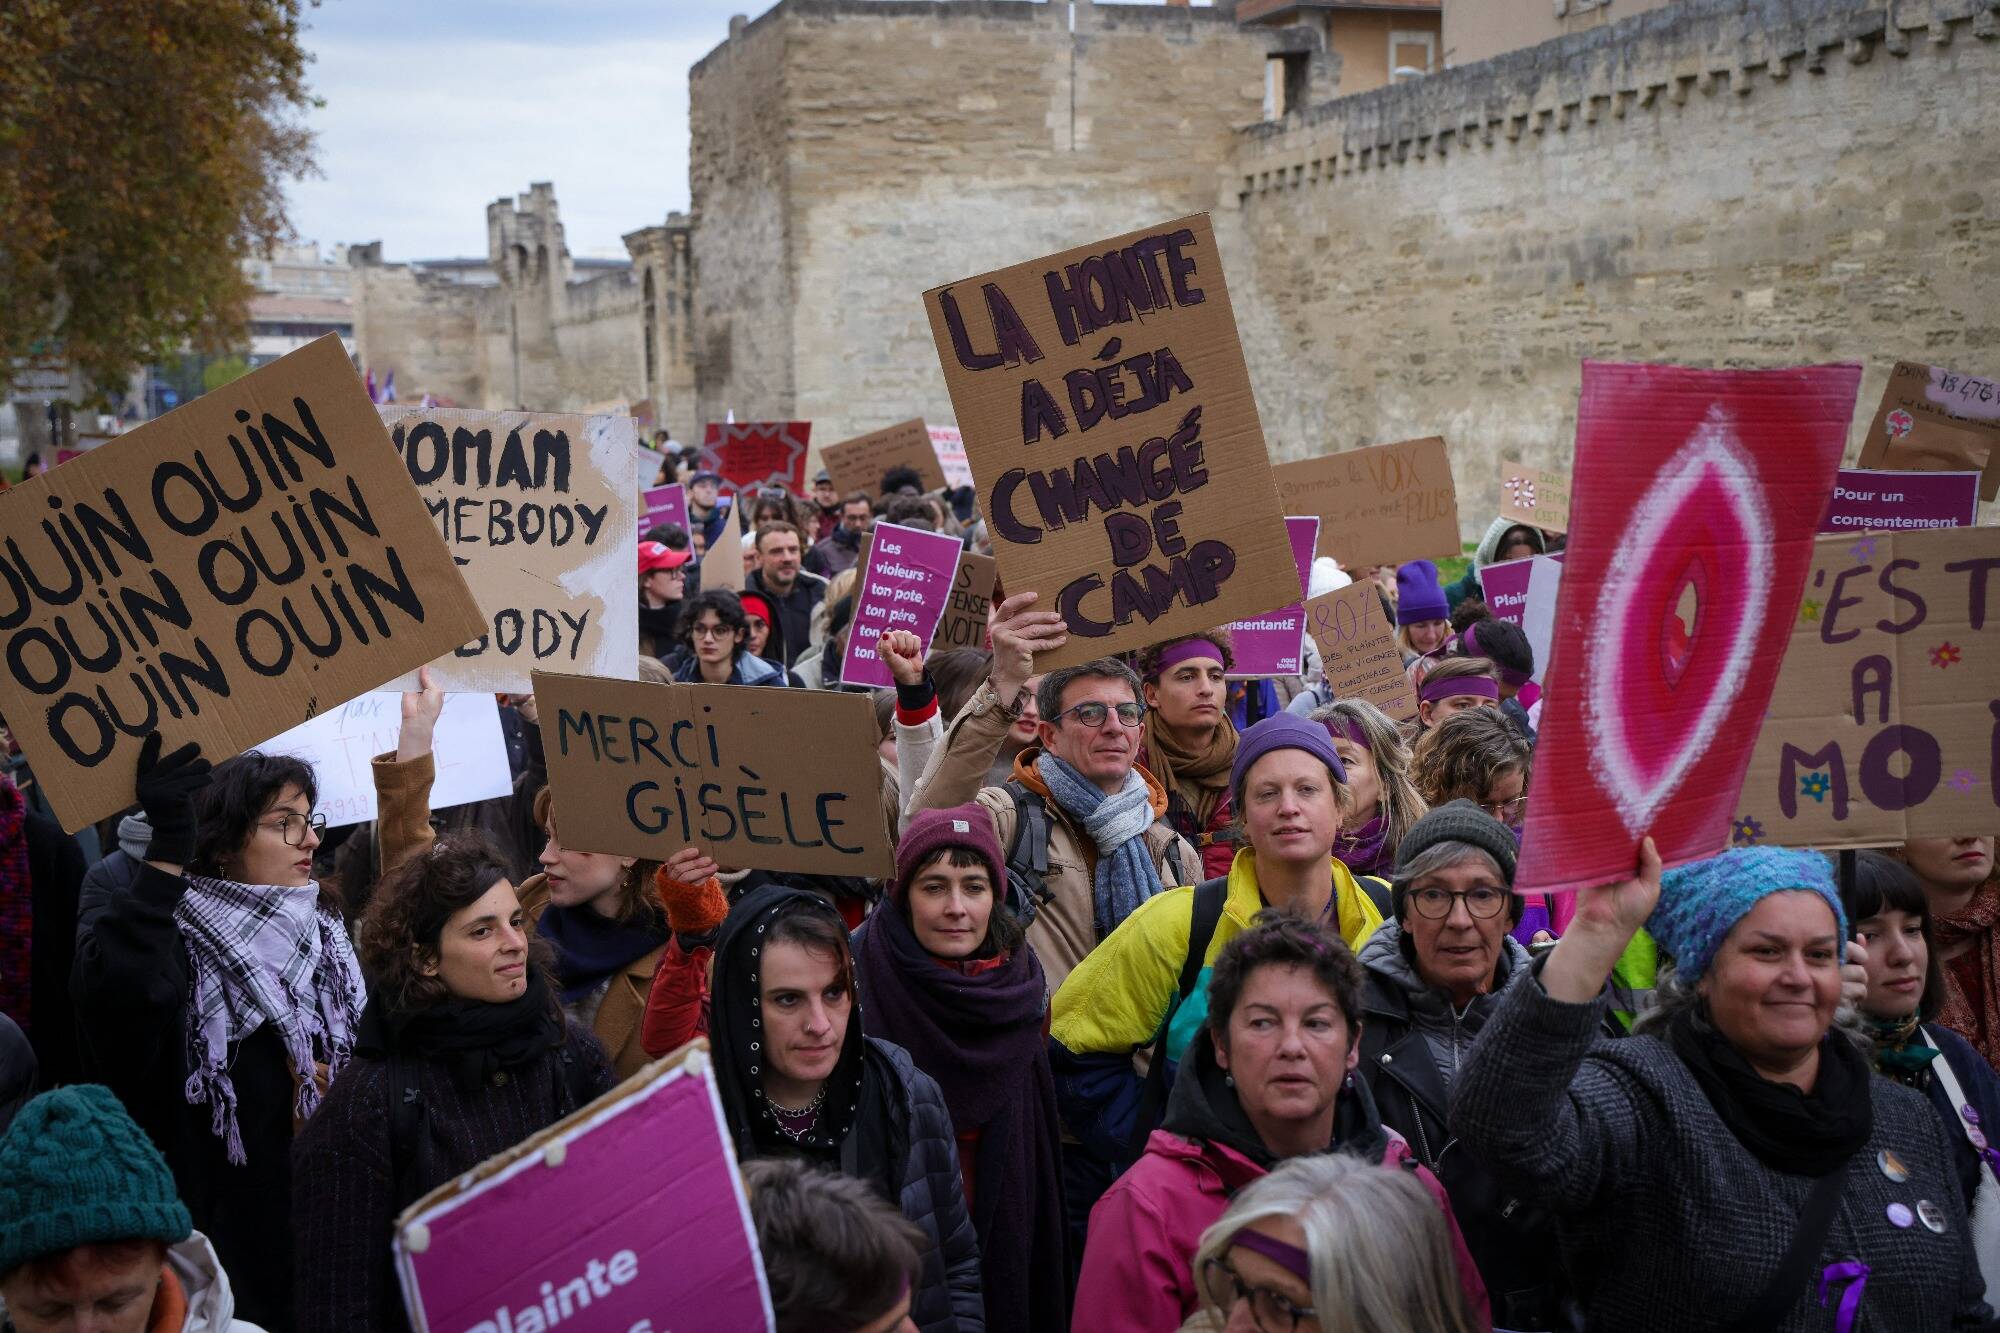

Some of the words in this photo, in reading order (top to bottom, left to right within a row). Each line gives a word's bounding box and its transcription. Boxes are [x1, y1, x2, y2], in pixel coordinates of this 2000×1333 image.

[938, 283, 1045, 371] LA
[1044, 228, 1205, 347] HONTE
[1020, 378, 1068, 445] A
[990, 405, 1209, 544] CHANGÉ
[1366, 449, 1422, 494] VOIX
[1403, 486, 1451, 526] PLUS
[1833, 487, 1876, 502] Pour
[1881, 492, 1904, 502] un
[423, 497, 608, 547] MEBODY
[1103, 500, 1186, 568] DE
[1831, 515, 1959, 529] consentement
[879, 539, 902, 555] Les
[876, 561, 925, 582] violeurs
[871, 582, 892, 598] ton
[894, 588, 926, 606] pote,
[1055, 539, 1236, 638] CAMP
[865, 603, 886, 618] ton
[859, 624, 880, 639] ton
[854, 645, 876, 660] ton
[1321, 651, 1343, 664] DES
[1851, 654, 1893, 725] A
